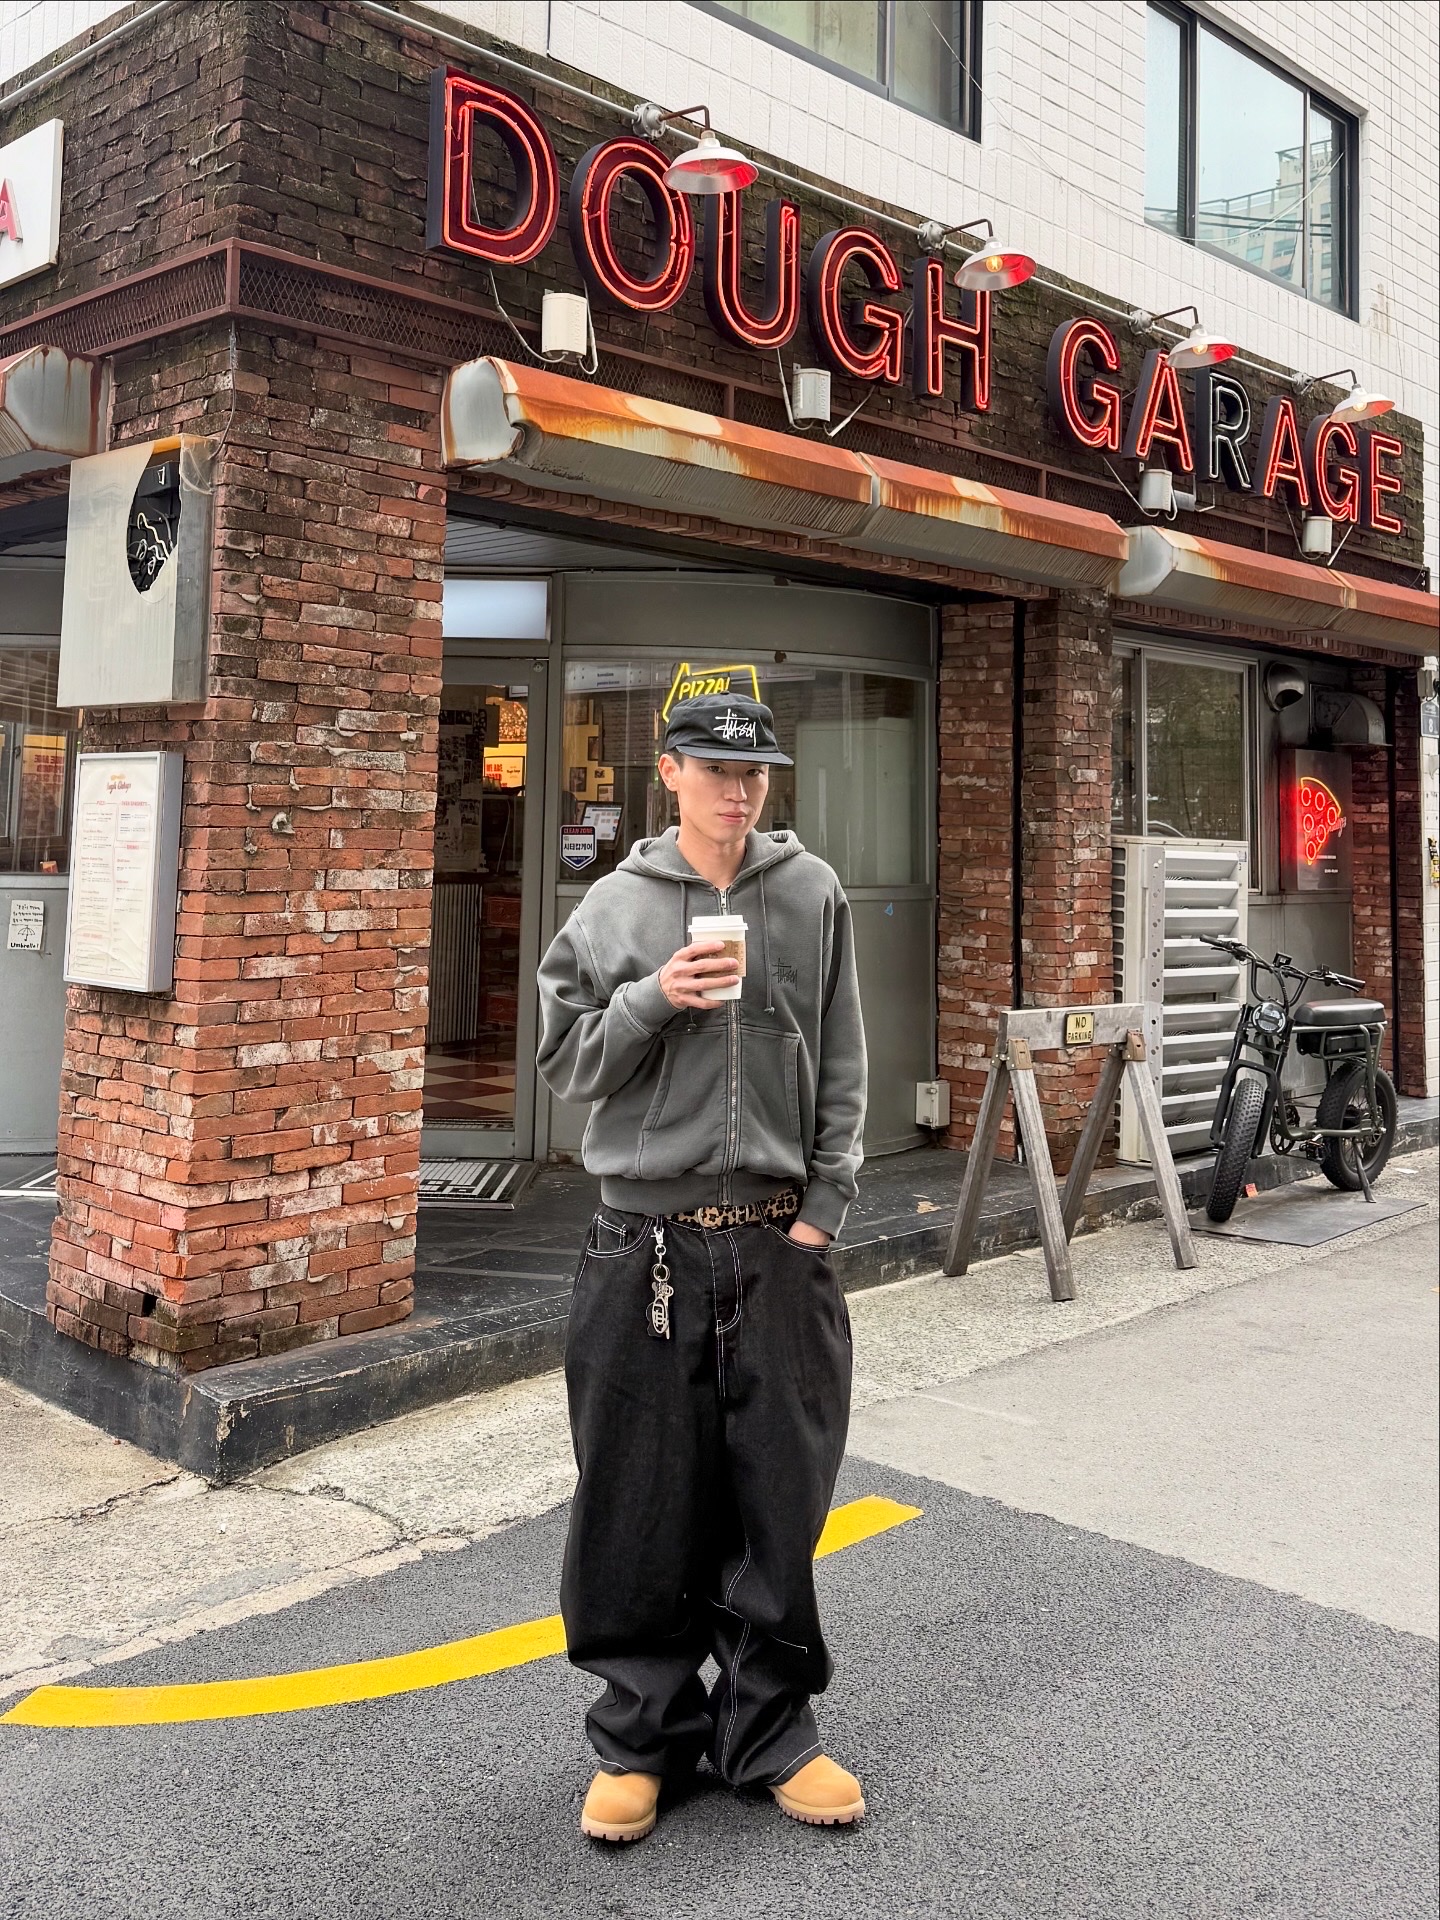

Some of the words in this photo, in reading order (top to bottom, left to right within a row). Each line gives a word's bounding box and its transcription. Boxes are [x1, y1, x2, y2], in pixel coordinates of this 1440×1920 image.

[427, 65, 992, 412] DOUGH
[1047, 316, 1403, 535] GARAGE
[1075, 1016, 1088, 1029] NO
[1067, 1030, 1092, 1041] PARKING
